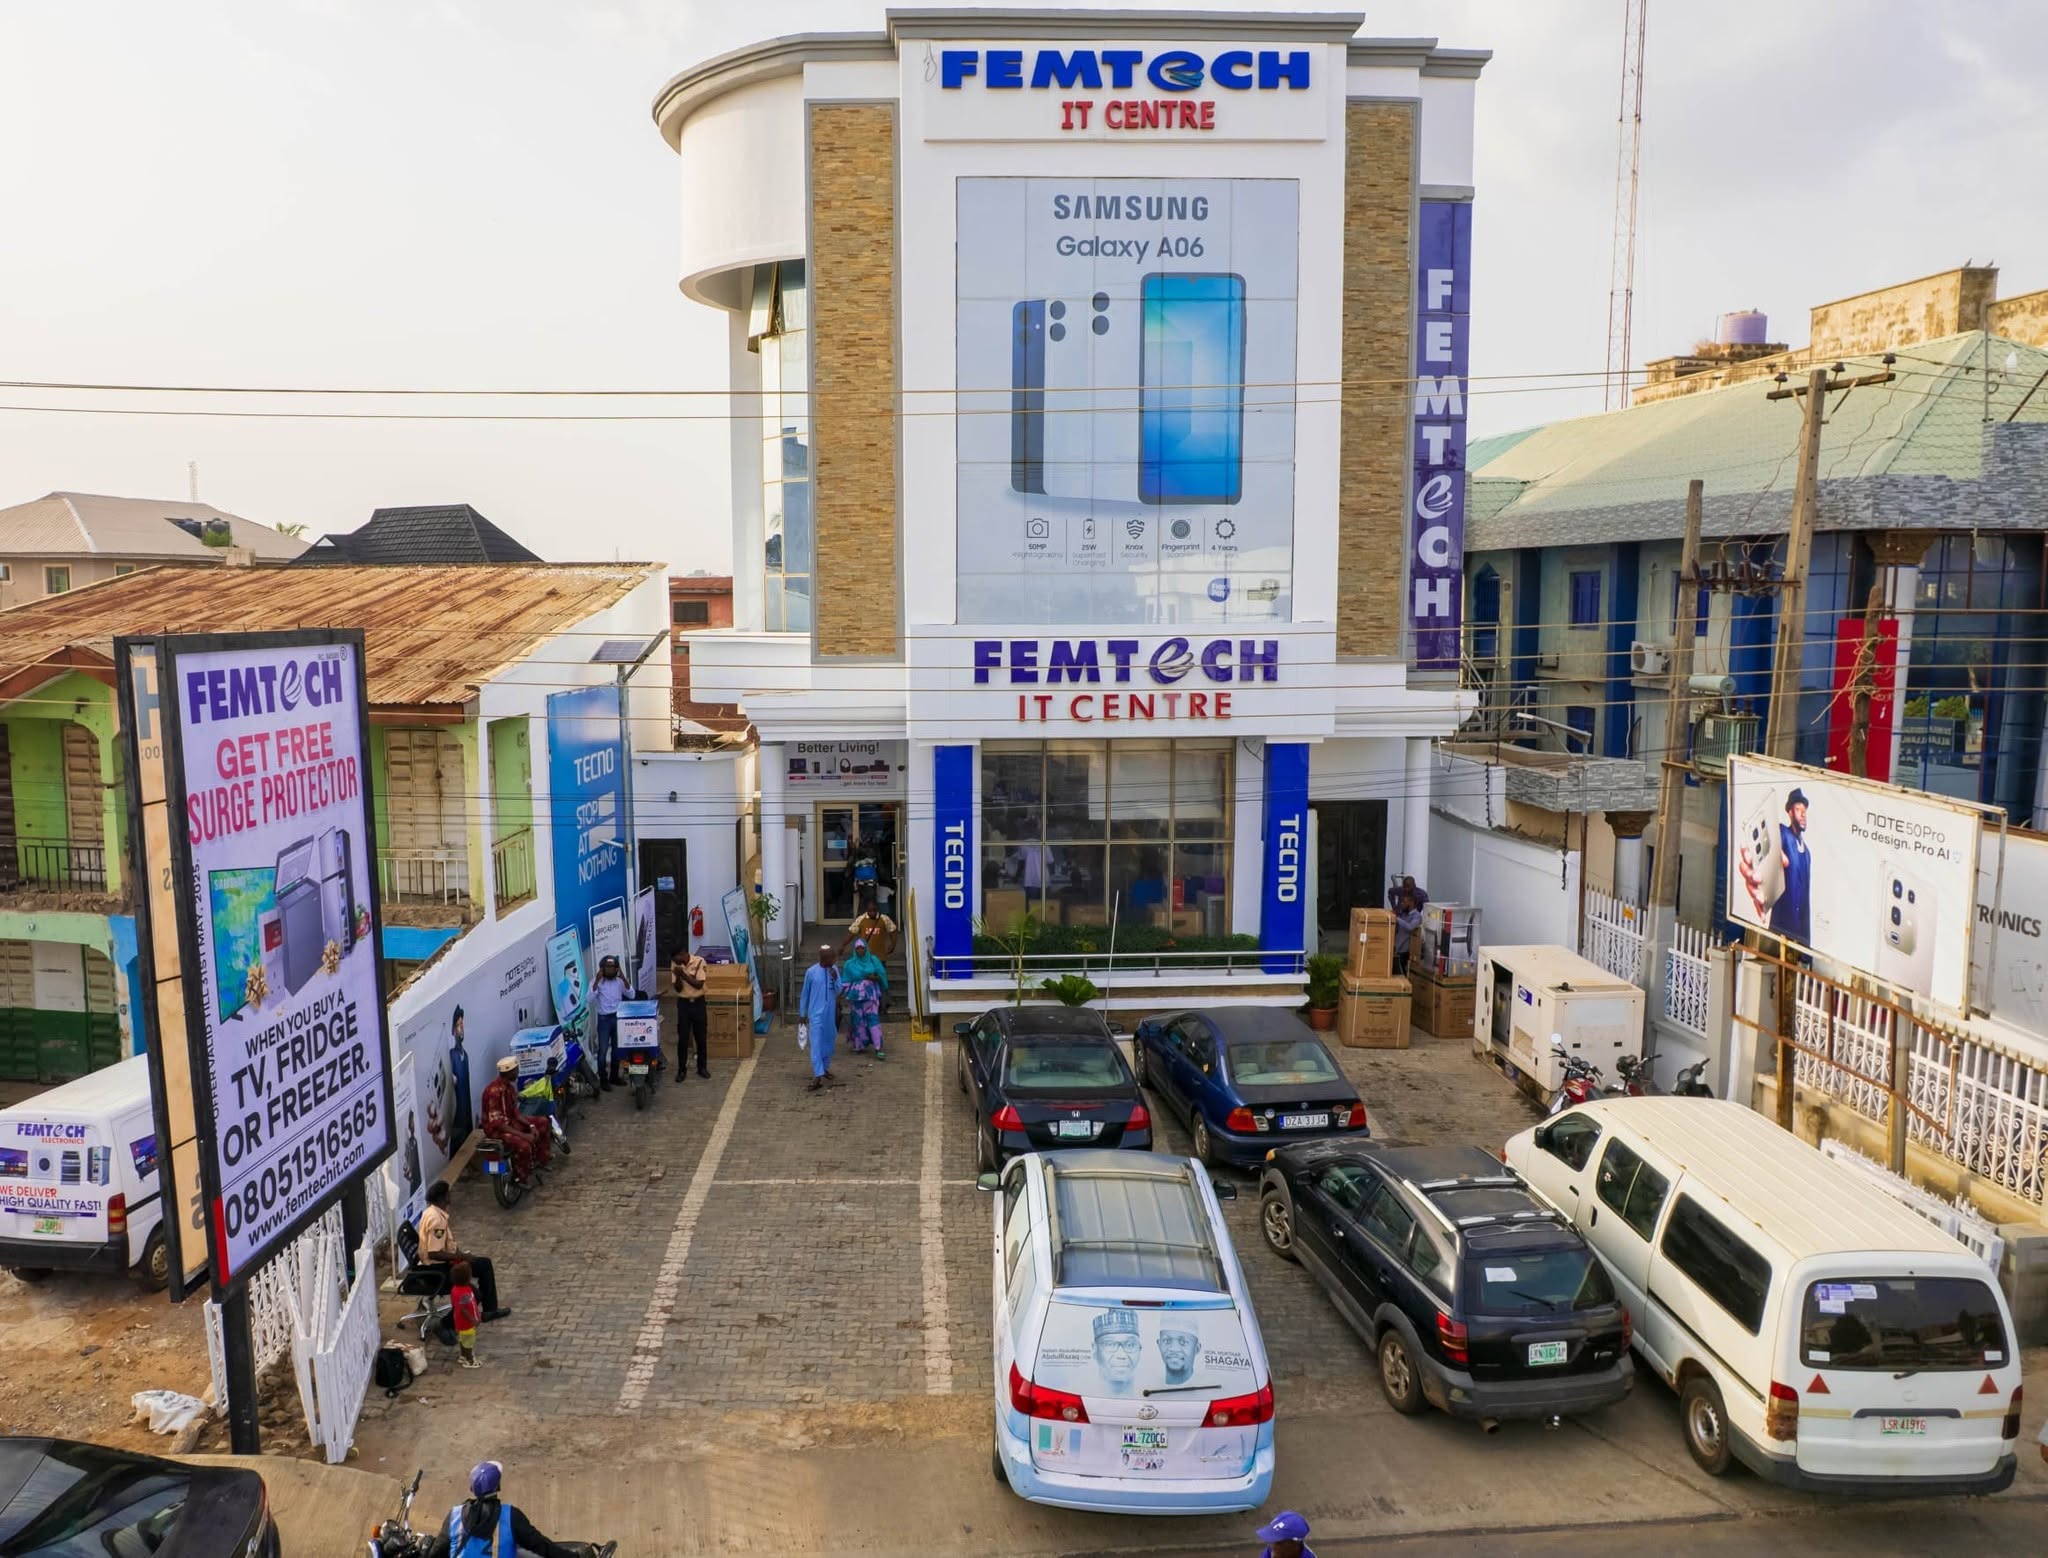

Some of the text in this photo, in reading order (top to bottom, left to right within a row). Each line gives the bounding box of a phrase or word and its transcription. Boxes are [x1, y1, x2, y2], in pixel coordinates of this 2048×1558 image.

[1061, 101, 1215, 130] IT CENTRE
[1053, 194, 1209, 222] SAMSUNG
[1056, 235, 1205, 264] Galaxy A06
[1161, 543, 1200, 552] Fingerprint
[1017, 692, 1232, 722] IT CENTRE
[216, 721, 334, 780] GET FREE
[797, 742, 880, 755] Better Living!
[574, 747, 614, 785] TECNO
[187, 756, 358, 845] SURGE PROTECTOR
[576, 800, 598, 830] STOP
[578, 831, 590, 858] AT
[1851, 824, 1950, 861] Pro design. Pro AI
[579, 847, 617, 886] NOTHING
[945, 820, 964, 909] TECNO
[1277, 814, 1300, 902] TECNO
[245, 988, 345, 1058] WHEN YOU BUY A
[231, 1002, 358, 1109] TV, FRIDGE
[223, 1042, 371, 1167] OR FREEZER.
[41, 1137, 84, 1145] ELECTRONICS
[225, 1090, 377, 1240] 08051516565
[0, 1185, 57, 1198] WE DELIVER
[0, 1196, 102, 1211] HIGH QUALITY FAST!
[248, 1142, 365, 1247] www.femtechit.com
[1204, 1355, 1251, 1368] SHAGAYA
[1123, 1432, 1138, 1443] KWL
